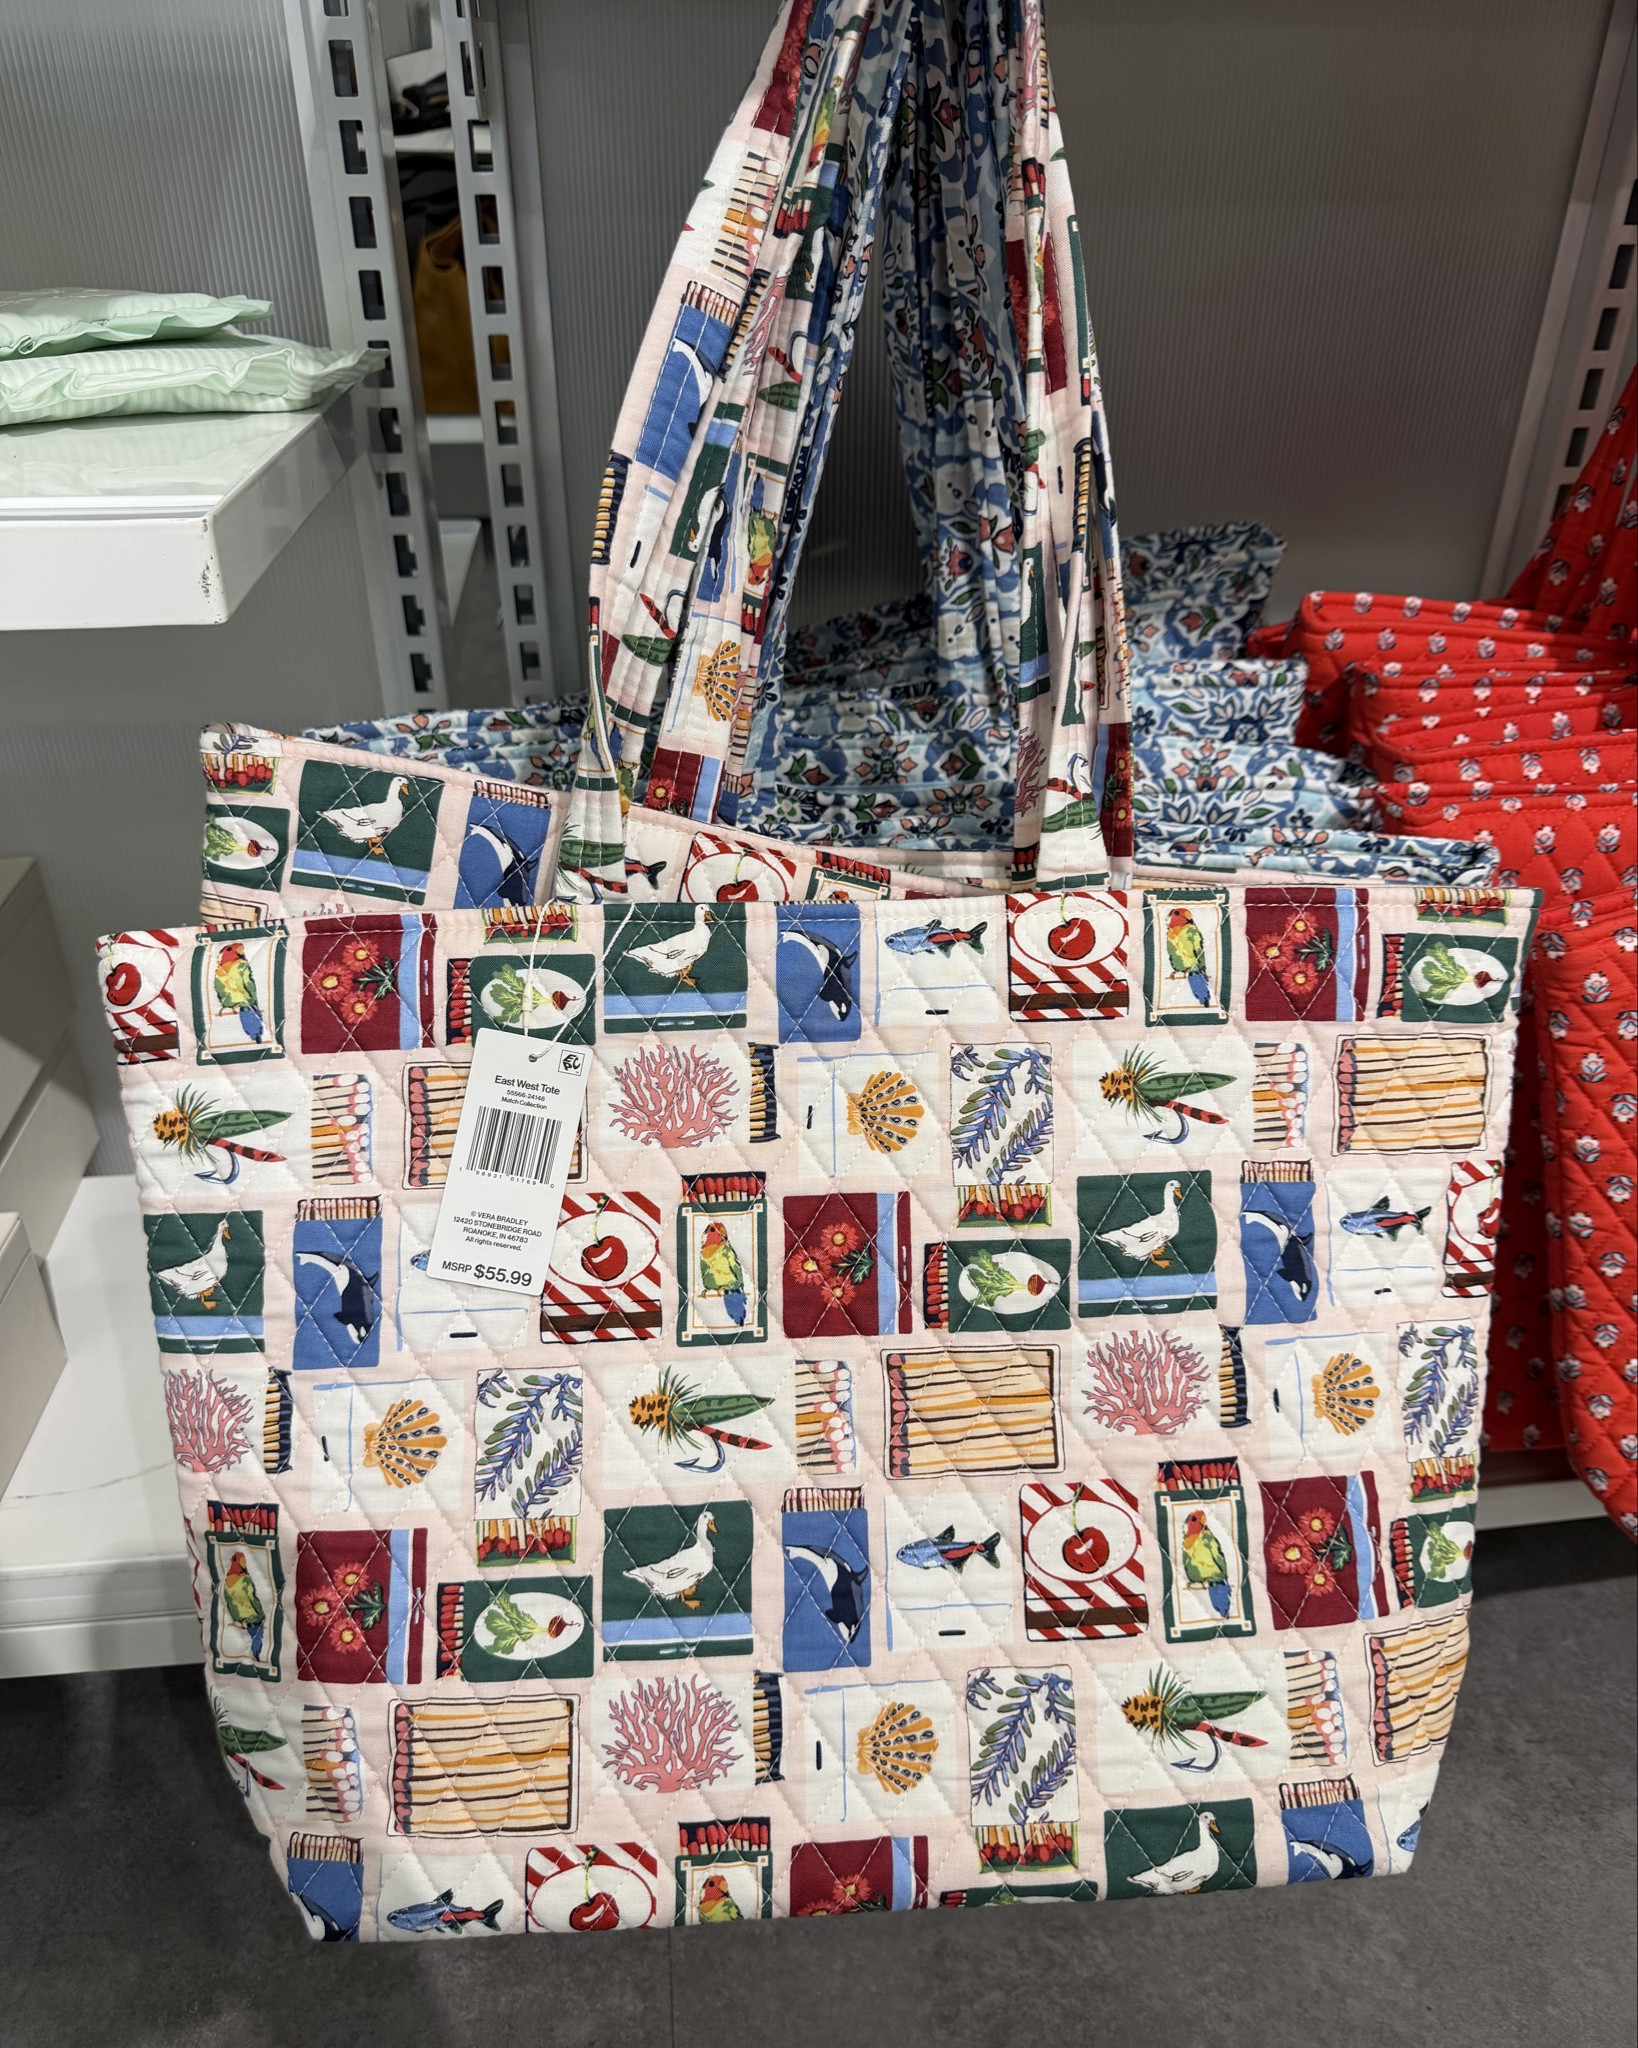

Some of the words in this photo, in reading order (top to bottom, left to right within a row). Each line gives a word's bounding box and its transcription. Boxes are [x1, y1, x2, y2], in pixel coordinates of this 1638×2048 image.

[494, 1074, 515, 1087] East
[517, 1078, 540, 1091] West
[541, 1083, 561, 1095] Tote
[501, 1096, 519, 1105] Match
[519, 1099, 548, 1110] Collection
[506, 1089, 546, 1101] 55566-24148
[477, 1211, 496, 1221] VERA
[496, 1215, 529, 1226] BRADLEY
[453, 1216, 474, 1225] 12420
[473, 1220, 522, 1234] STONEBRIDGE
[522, 1228, 542, 1238] ROAD
[463, 1227, 498, 1239] ROANOKE,
[506, 1234, 529, 1244] 46783
[474, 1237, 493, 1247] rights
[493, 1241, 522, 1251] reserved.
[442, 1260, 473, 1273] MSRP
[473, 1263, 533, 1287] $55.99
